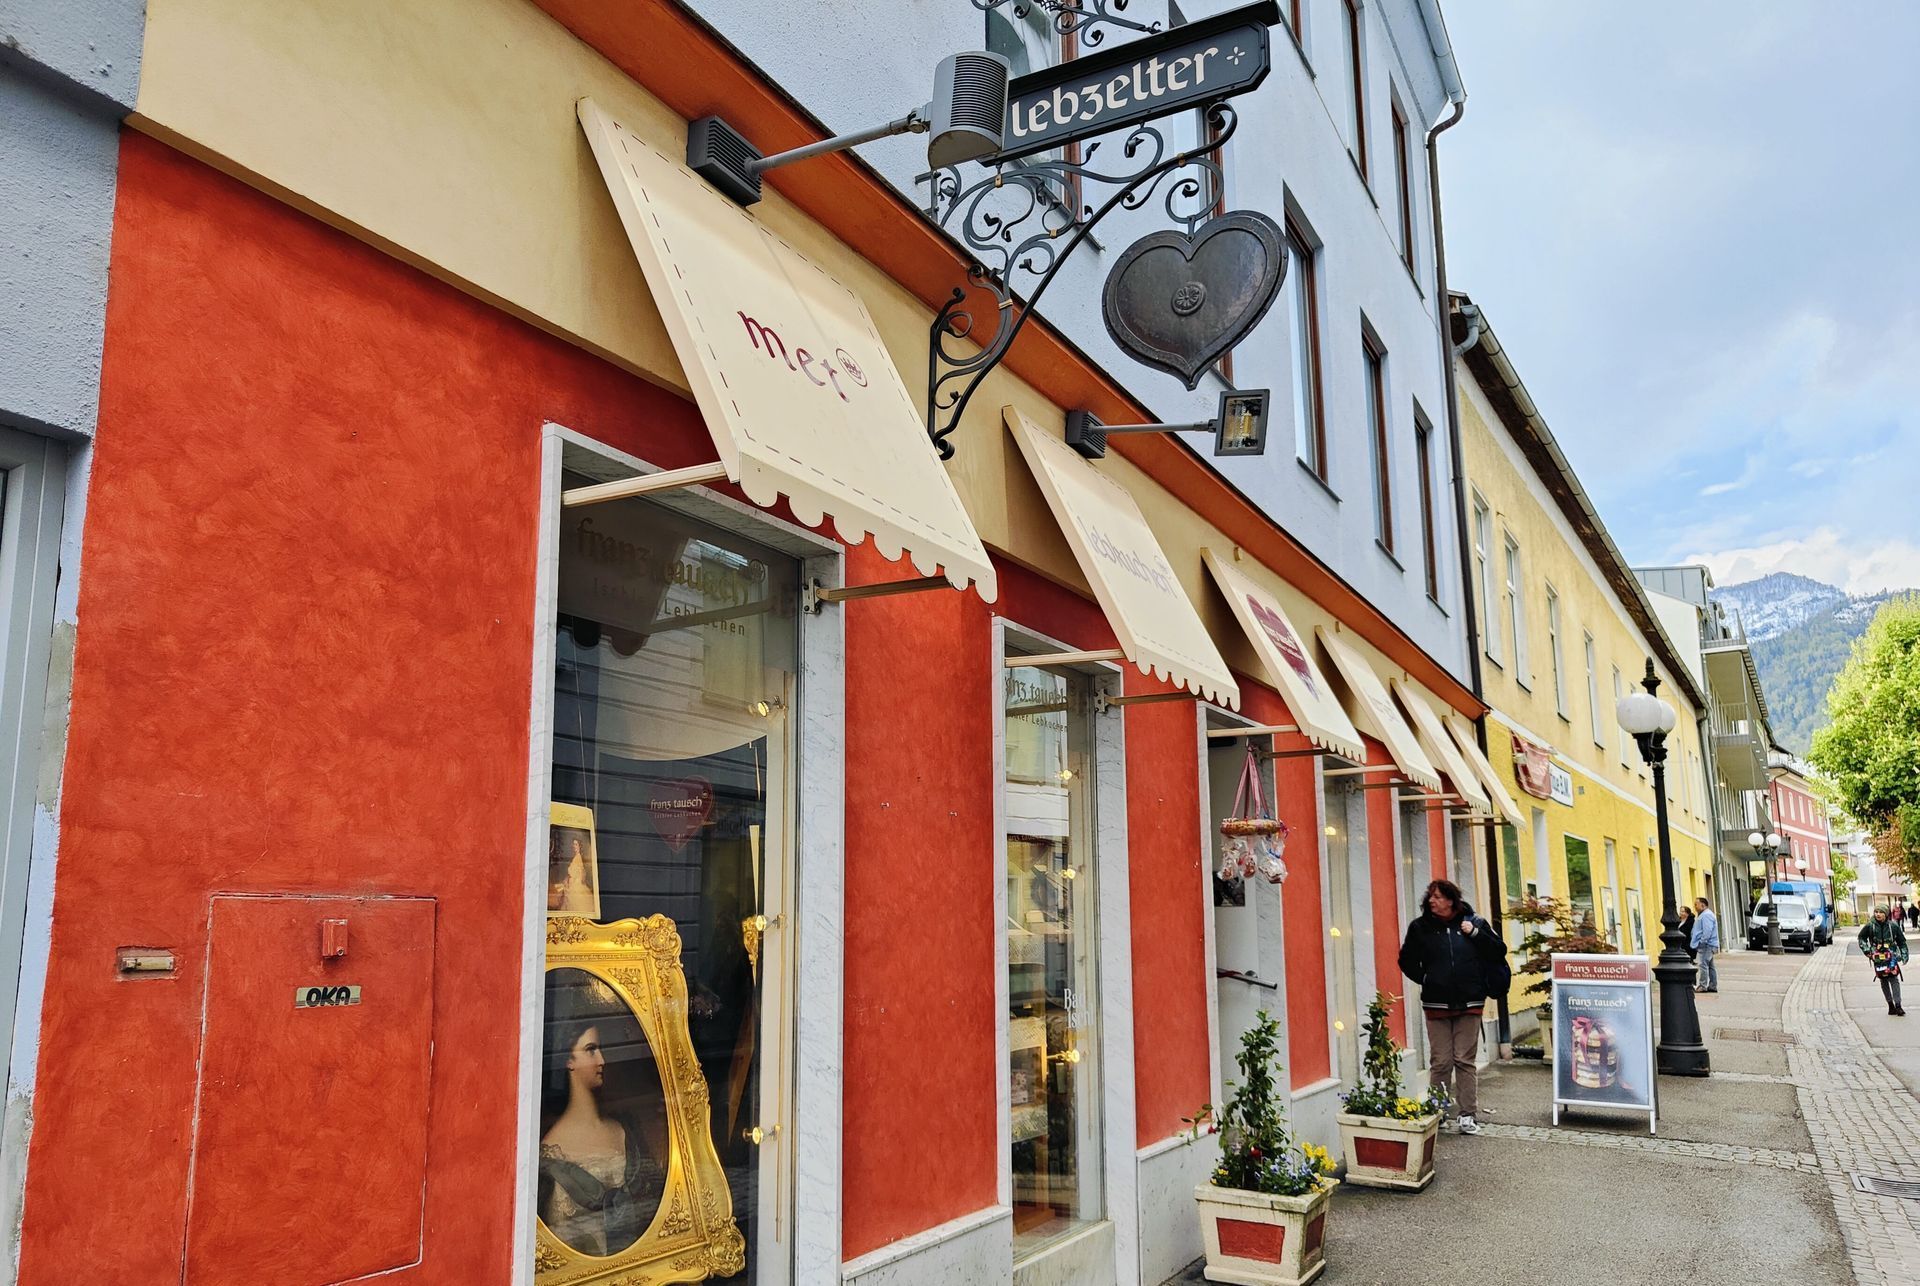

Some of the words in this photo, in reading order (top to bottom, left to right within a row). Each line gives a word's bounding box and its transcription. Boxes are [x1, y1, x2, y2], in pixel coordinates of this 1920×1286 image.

[1011, 47, 1219, 137] lebzelter
[1593, 965, 1628, 974] tausch
[305, 986, 351, 1008] OKA
[1594, 998, 1627, 1007] tausch
